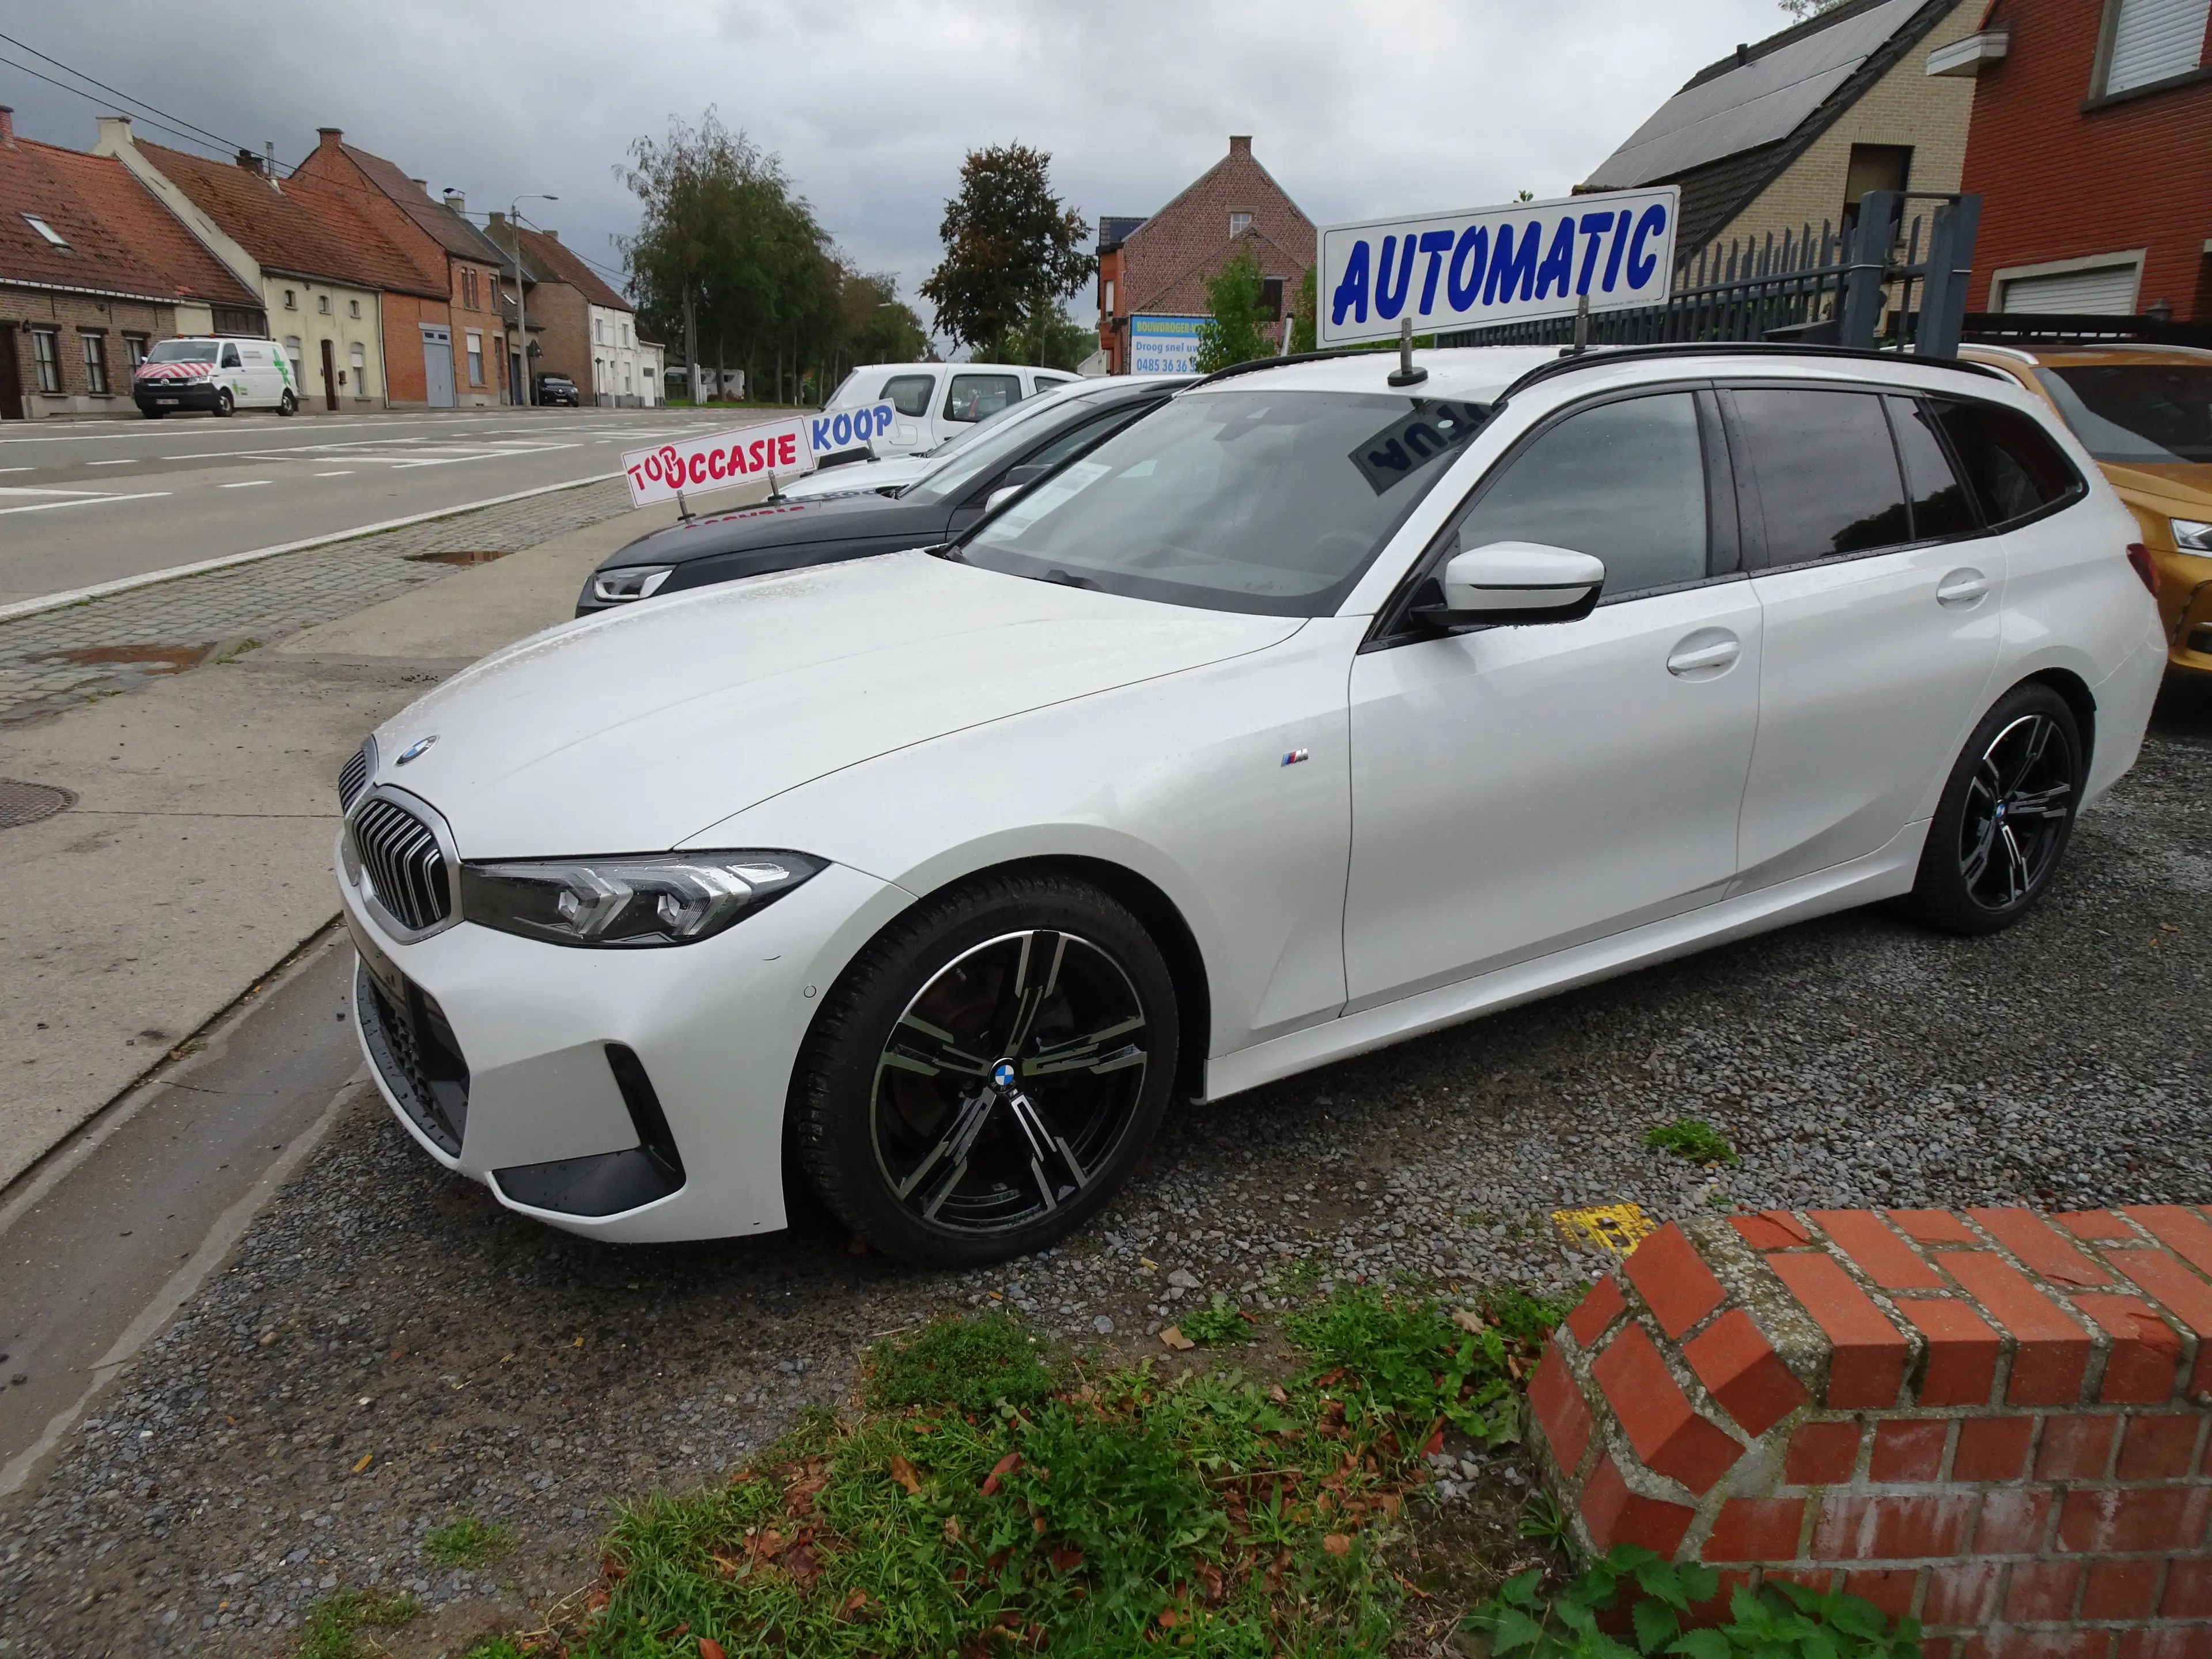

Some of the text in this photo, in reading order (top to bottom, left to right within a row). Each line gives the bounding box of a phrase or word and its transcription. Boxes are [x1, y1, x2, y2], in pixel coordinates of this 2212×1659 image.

[1331, 203, 1666, 326] AUTOMATIC
[1136, 342, 1162, 354] Droog
[1165, 342, 1184, 352] snel
[1137, 358, 1160, 371] 0485
[1162, 359, 1173, 372] 36
[1176, 359, 1187, 373] 36
[812, 405, 893, 451] KOOP
[627, 433, 796, 490] TOP OCCASIE
